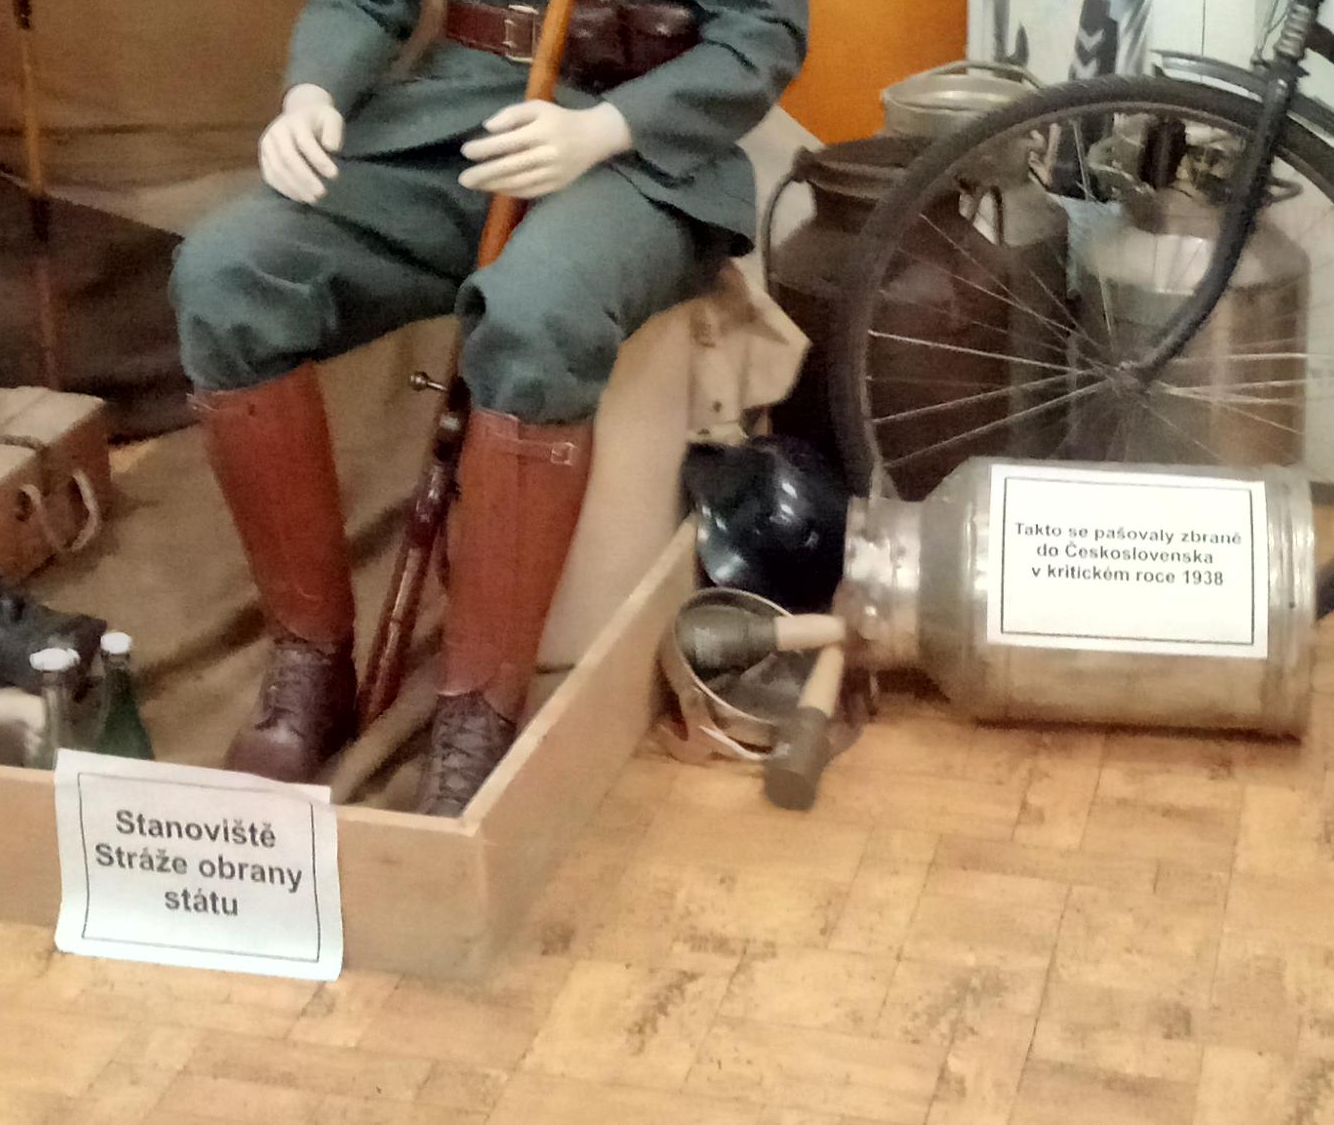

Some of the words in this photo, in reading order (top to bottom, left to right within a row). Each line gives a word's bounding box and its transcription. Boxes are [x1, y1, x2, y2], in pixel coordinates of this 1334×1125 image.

[1015, 522, 1062, 538] Takto
[1068, 526, 1089, 539] se
[1094, 525, 1174, 545] pašovaly
[1180, 528, 1242, 546] zbraně
[1036, 542, 1059, 557] do
[1065, 540, 1214, 565] Československa
[1032, 566, 1041, 578] v
[1047, 563, 1130, 582] kritickém
[1135, 571, 1175, 585] roce
[1182, 569, 1224, 587] 1938
[115, 809, 276, 849] Stanoviště
[95, 841, 188, 876] Stráže
[198, 855, 303, 894] obrany
[164, 887, 239, 917] státu
